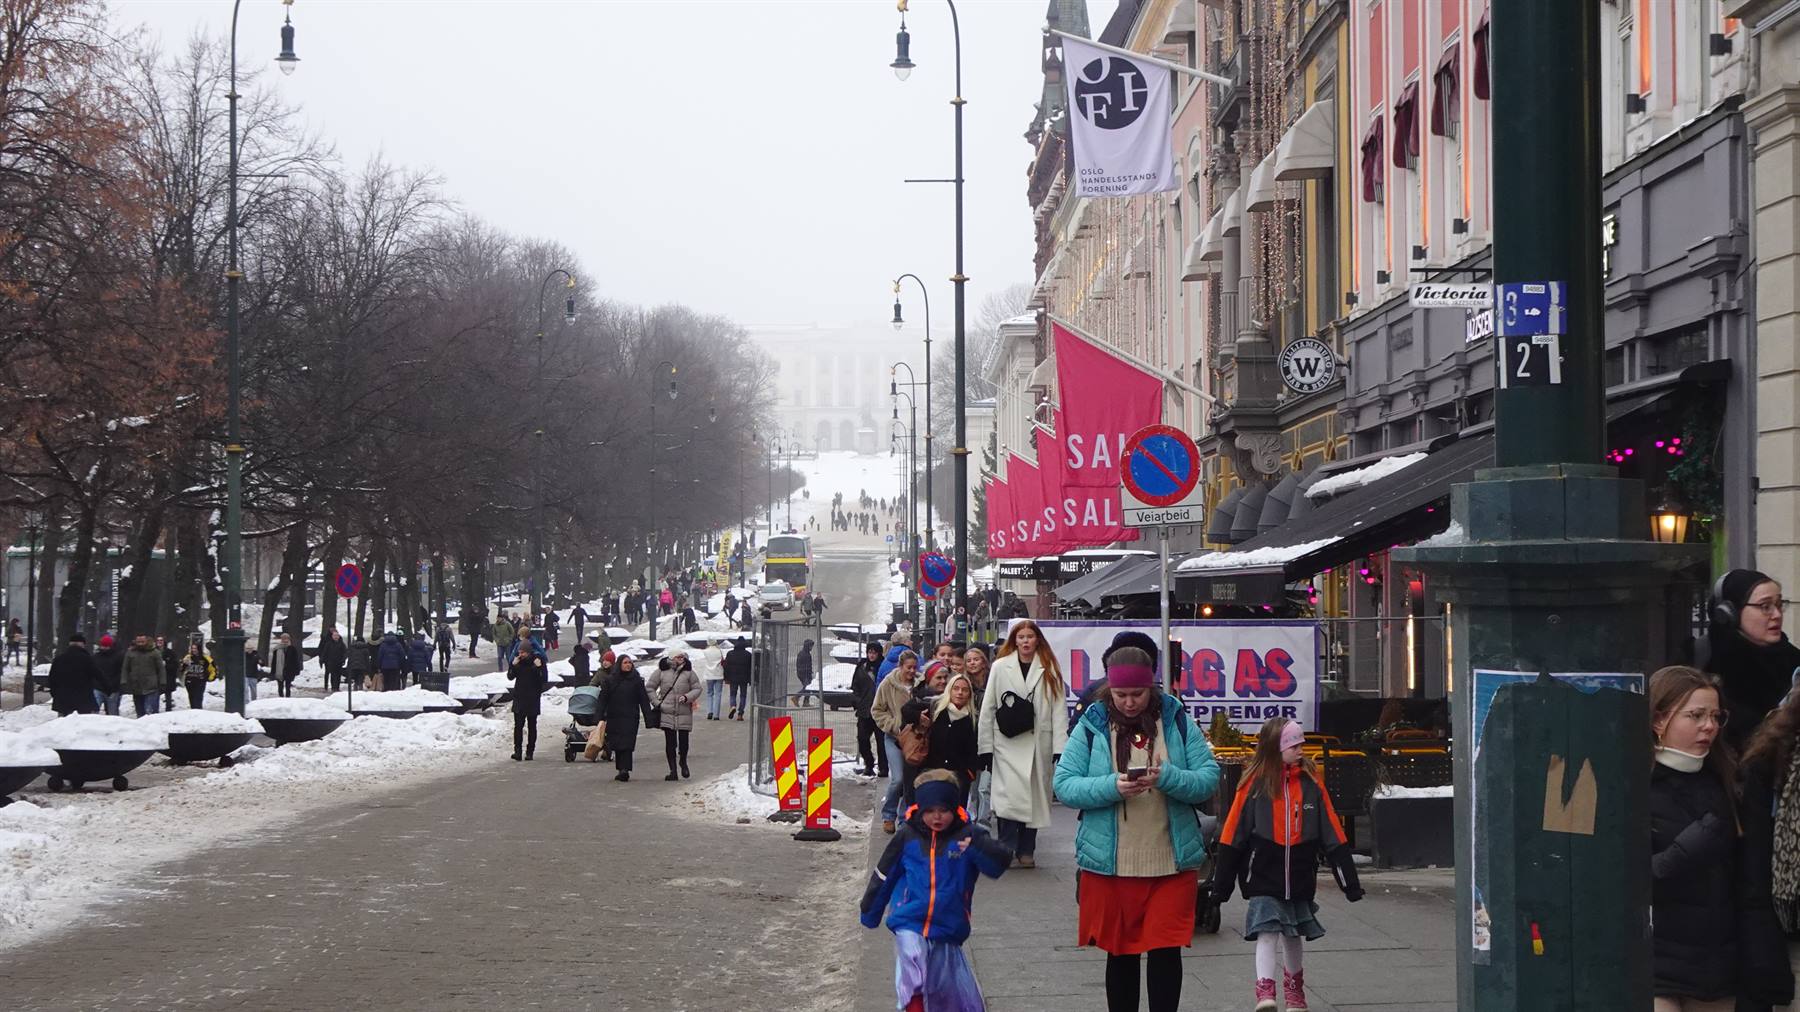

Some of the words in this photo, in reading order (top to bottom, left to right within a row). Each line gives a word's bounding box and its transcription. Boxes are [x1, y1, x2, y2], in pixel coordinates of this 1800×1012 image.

[1081, 172, 1157, 184] HANDELSSTANDS
[1082, 184, 1128, 192] FORENING
[1414, 286, 1488, 299] Victoria
[1506, 291, 1518, 326] 3
[1516, 342, 1531, 377] 2
[1293, 357, 1321, 377] W
[1063, 498, 1118, 526] SAL
[1136, 510, 1190, 524] Veiarbeid
[1000, 567, 1021, 575] PALEET
[1060, 561, 1079, 572] PALEET
